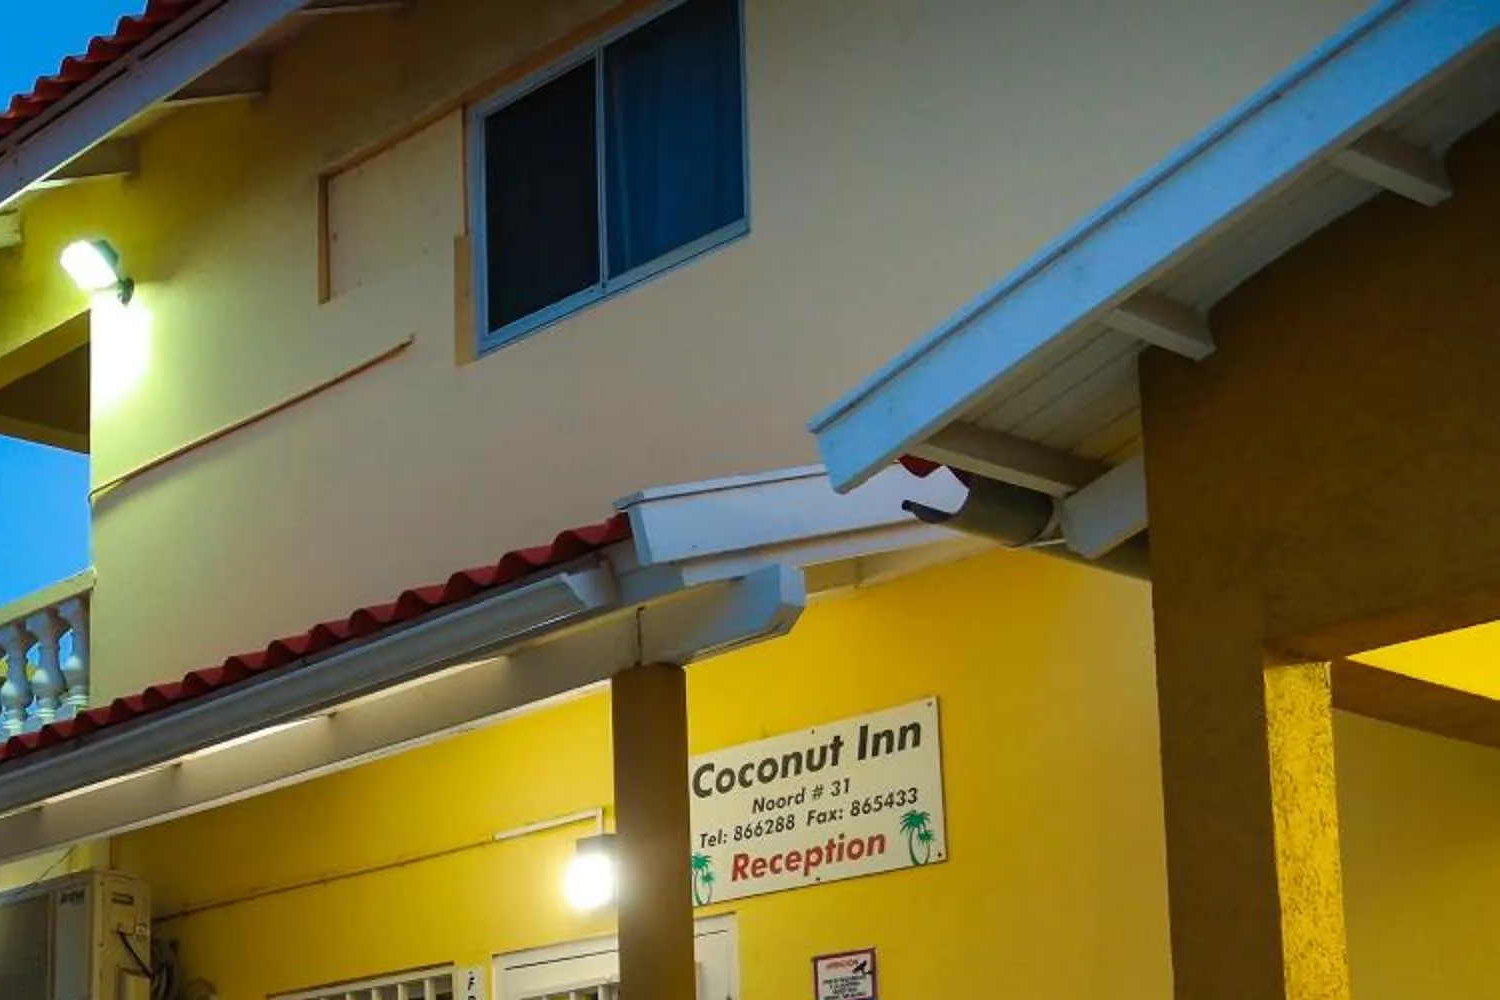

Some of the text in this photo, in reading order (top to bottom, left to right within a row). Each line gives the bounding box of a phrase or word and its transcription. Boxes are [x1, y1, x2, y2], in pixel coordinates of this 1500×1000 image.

[692, 721, 922, 798] Coconut Inn
[699, 786, 919, 849] Tel: 866288 Fax: 865433
[751, 778, 851, 814] Noord # 31
[731, 832, 887, 882] Reception
